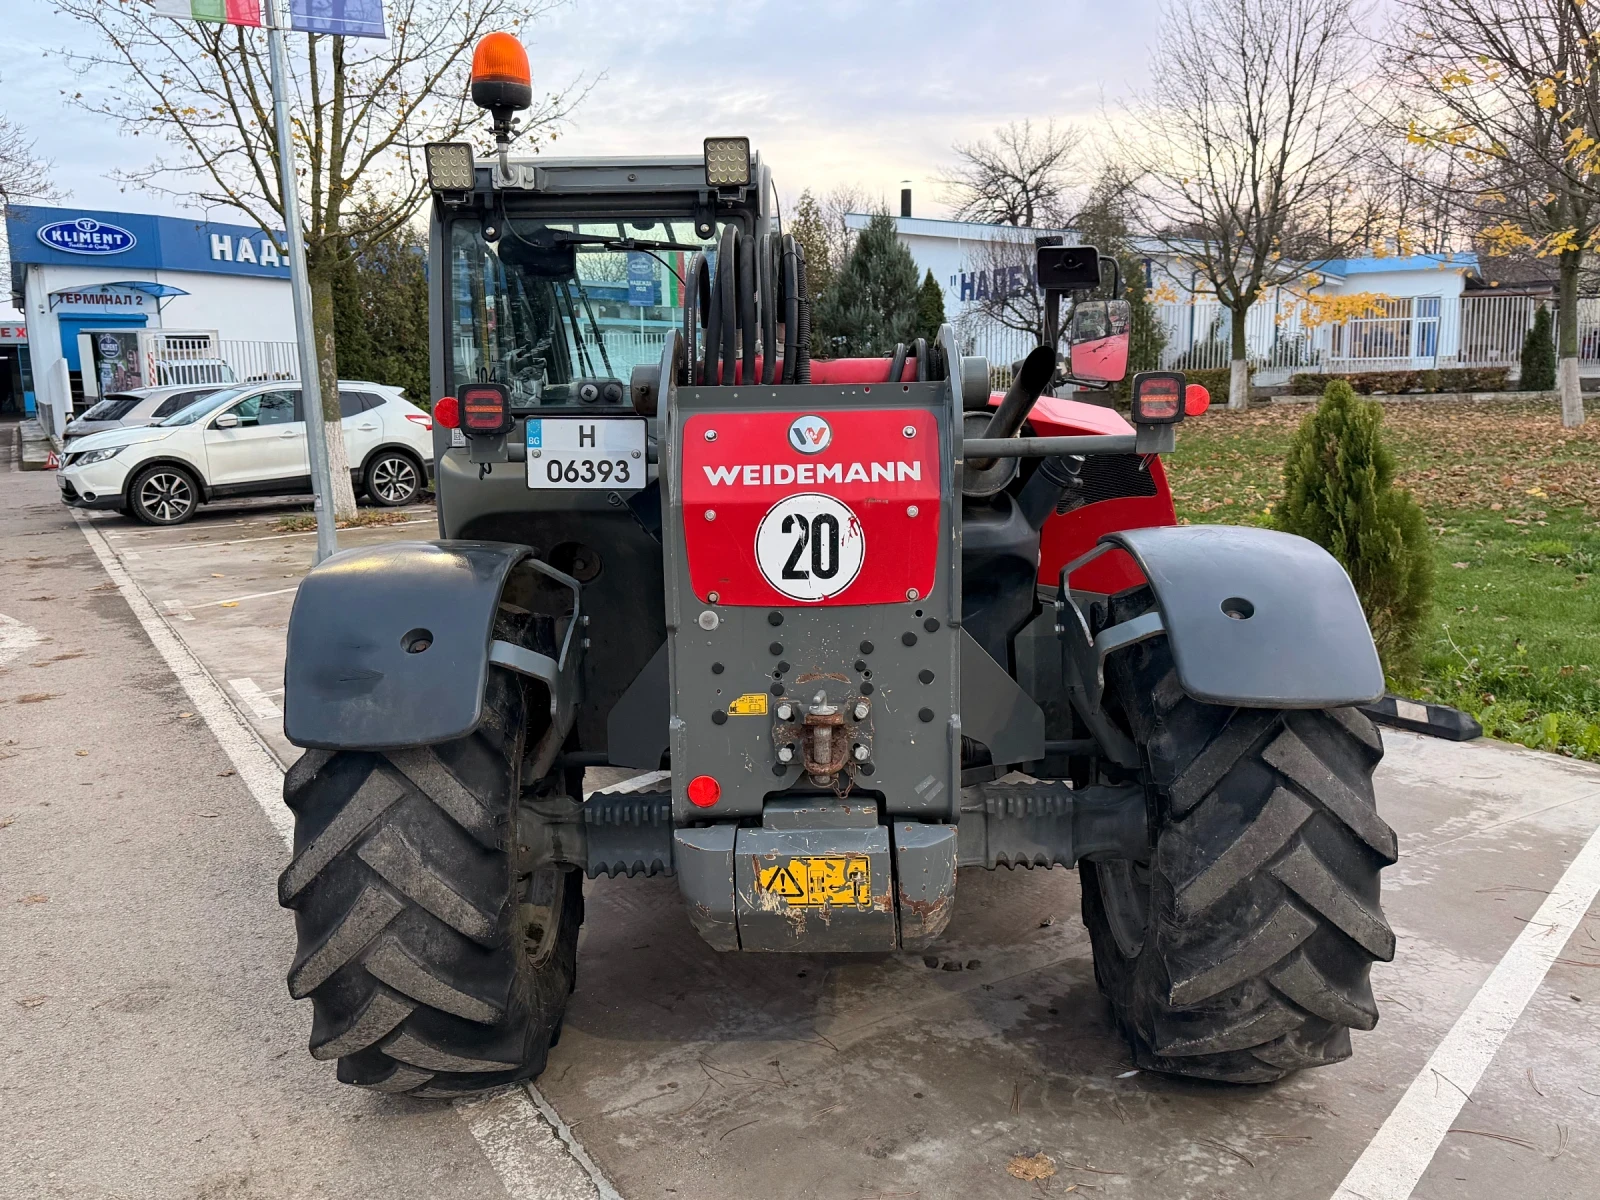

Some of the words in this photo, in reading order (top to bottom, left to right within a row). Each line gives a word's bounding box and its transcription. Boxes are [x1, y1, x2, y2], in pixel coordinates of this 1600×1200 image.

[51, 230, 123, 245] KLIMENT
[59, 293, 132, 305] ТЕРМИНАЛ
[135, 295, 143, 305] 2
[475, 366, 497, 383] 104
[528, 436, 540, 445] BG
[579, 425, 596, 447] H
[547, 460, 630, 483] 06393
[703, 461, 921, 486] WEIDEMANN
[781, 513, 839, 579] 20
